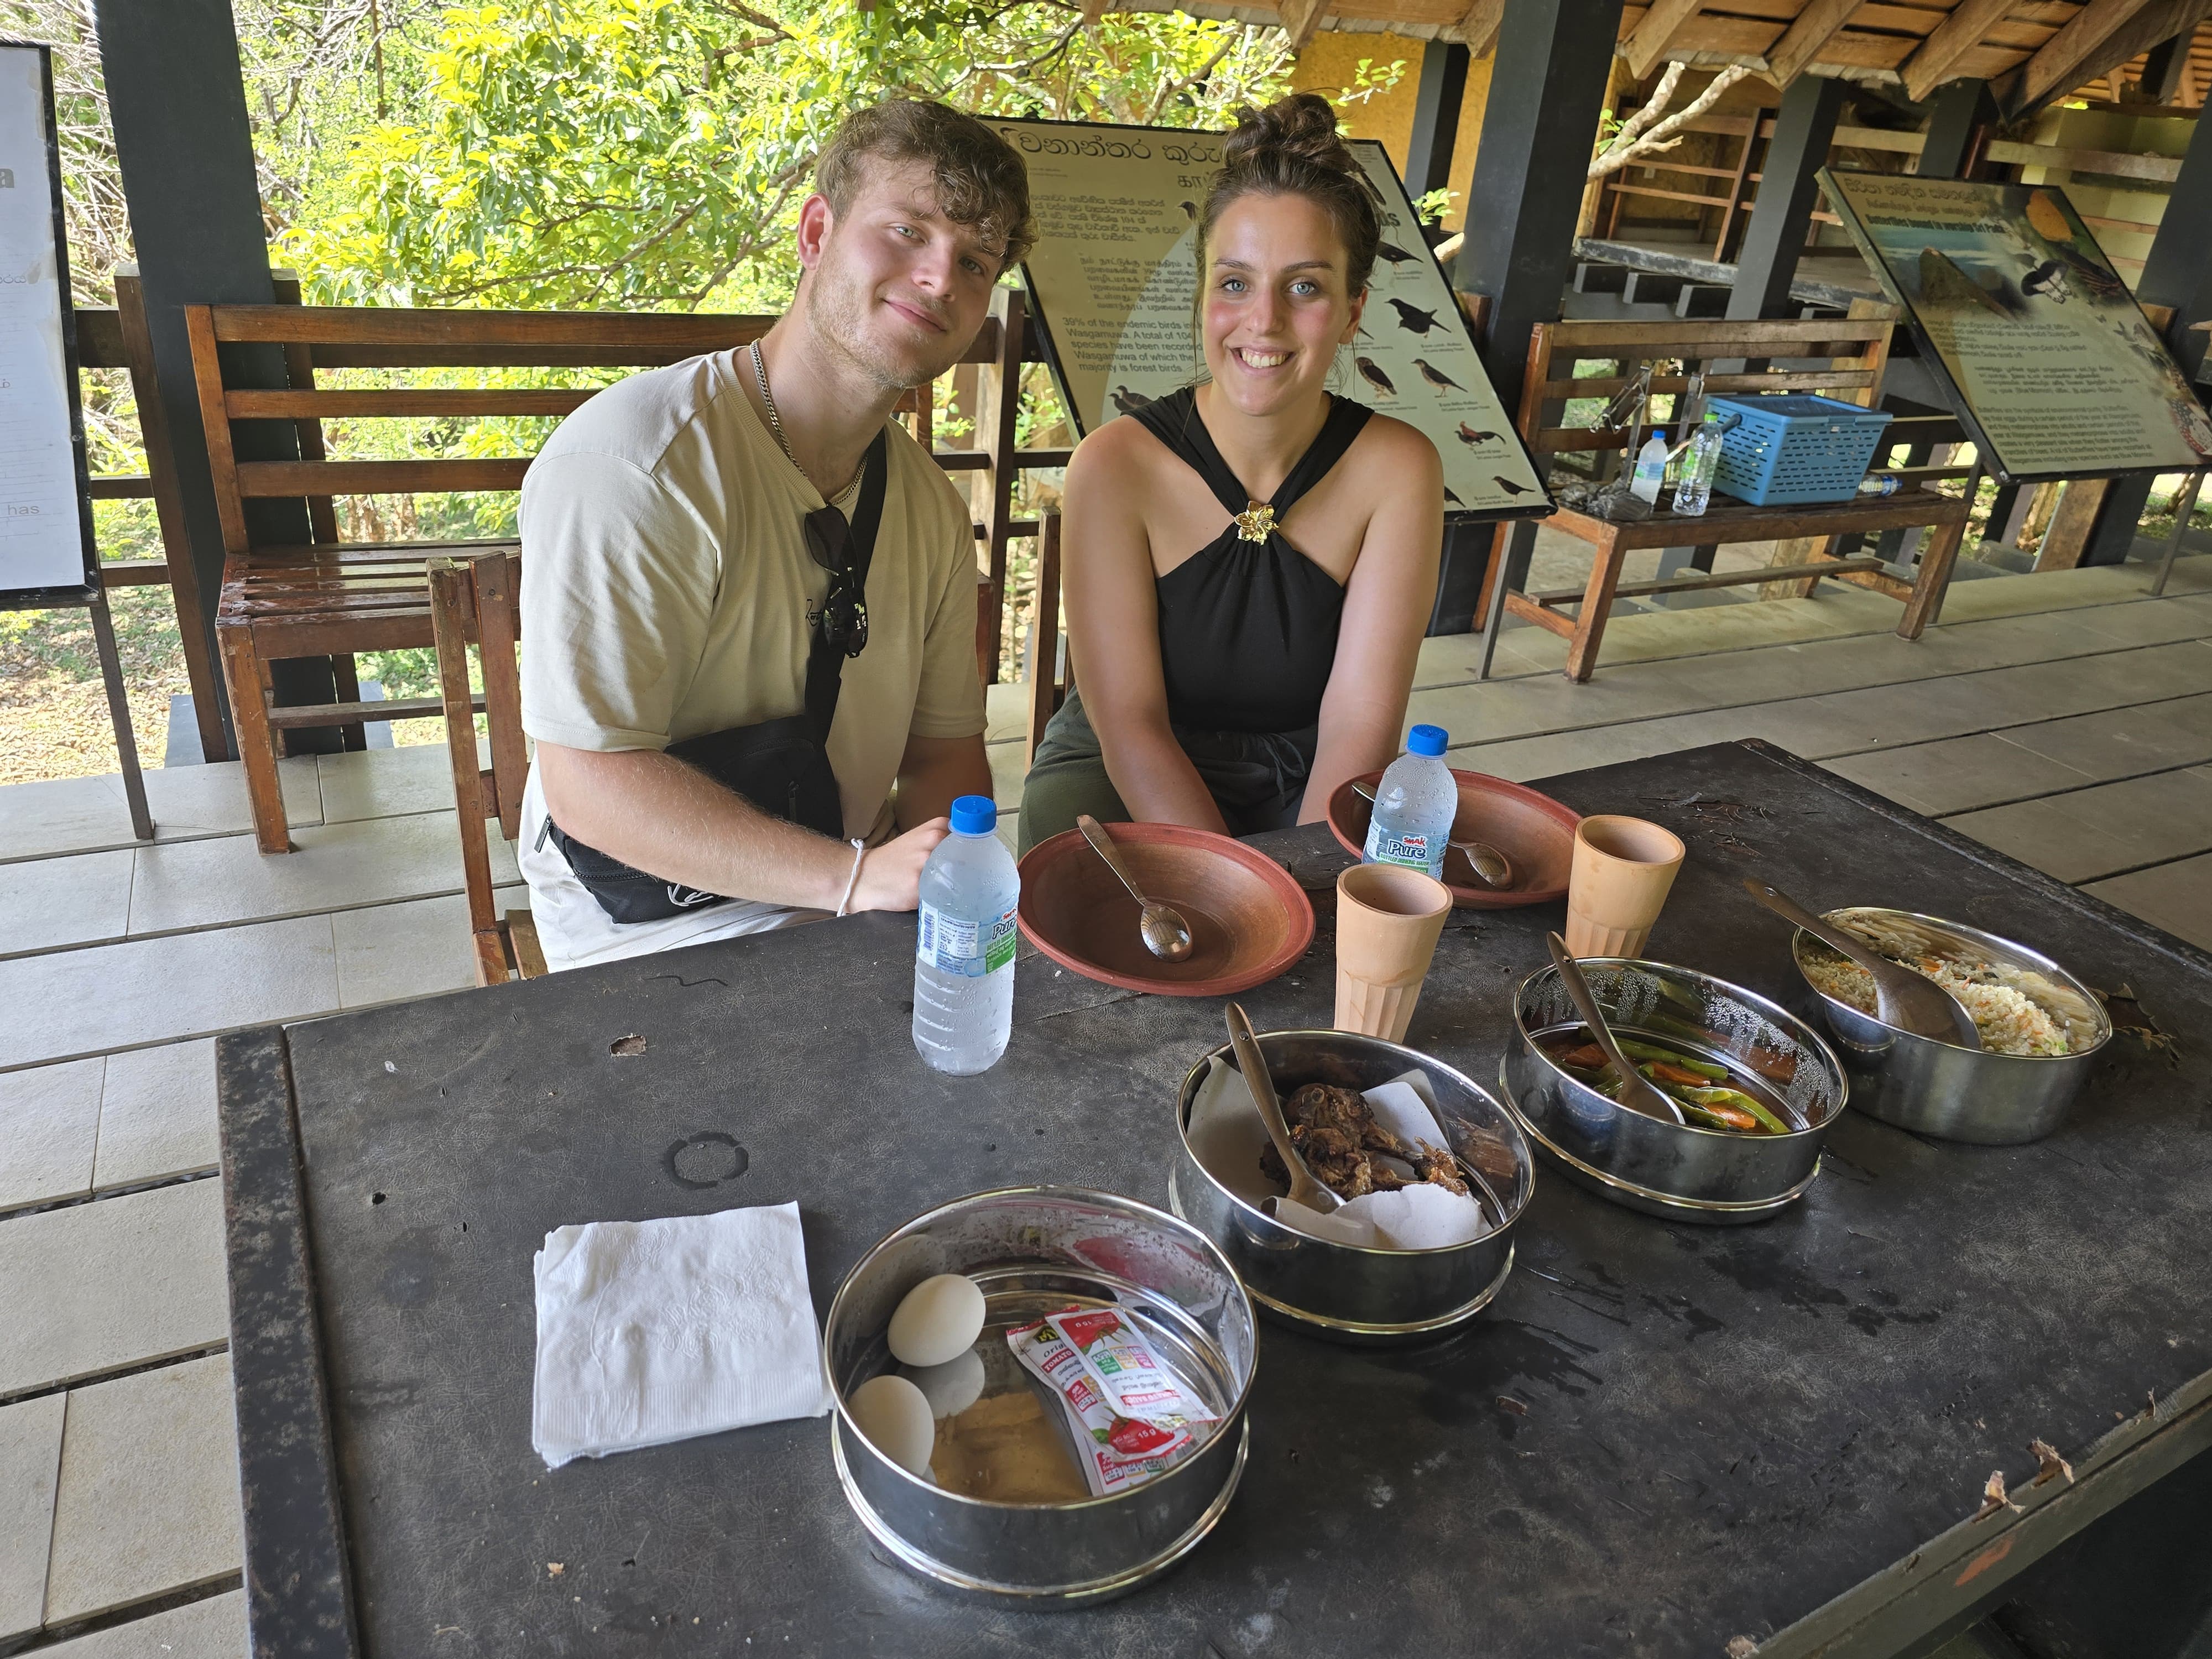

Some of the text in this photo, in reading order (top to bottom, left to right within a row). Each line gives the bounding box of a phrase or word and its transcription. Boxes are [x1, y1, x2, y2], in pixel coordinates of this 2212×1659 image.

[1018, 131, 1151, 160] වනාන්තර
[1117, 319, 1155, 327] endemic
[1071, 340, 1107, 350] species
[1076, 351, 1135, 362] Wasgamuwa
[1150, 352, 1176, 361] which
[1079, 362, 1116, 373] majority
[8, 504, 40, 515] has
[1388, 840, 1426, 859] Pure
[1380, 853, 1397, 862] BOTTLED
[1044, 1350, 1072, 1371] TOMATO
[1138, 1430, 1149, 1438] 15
